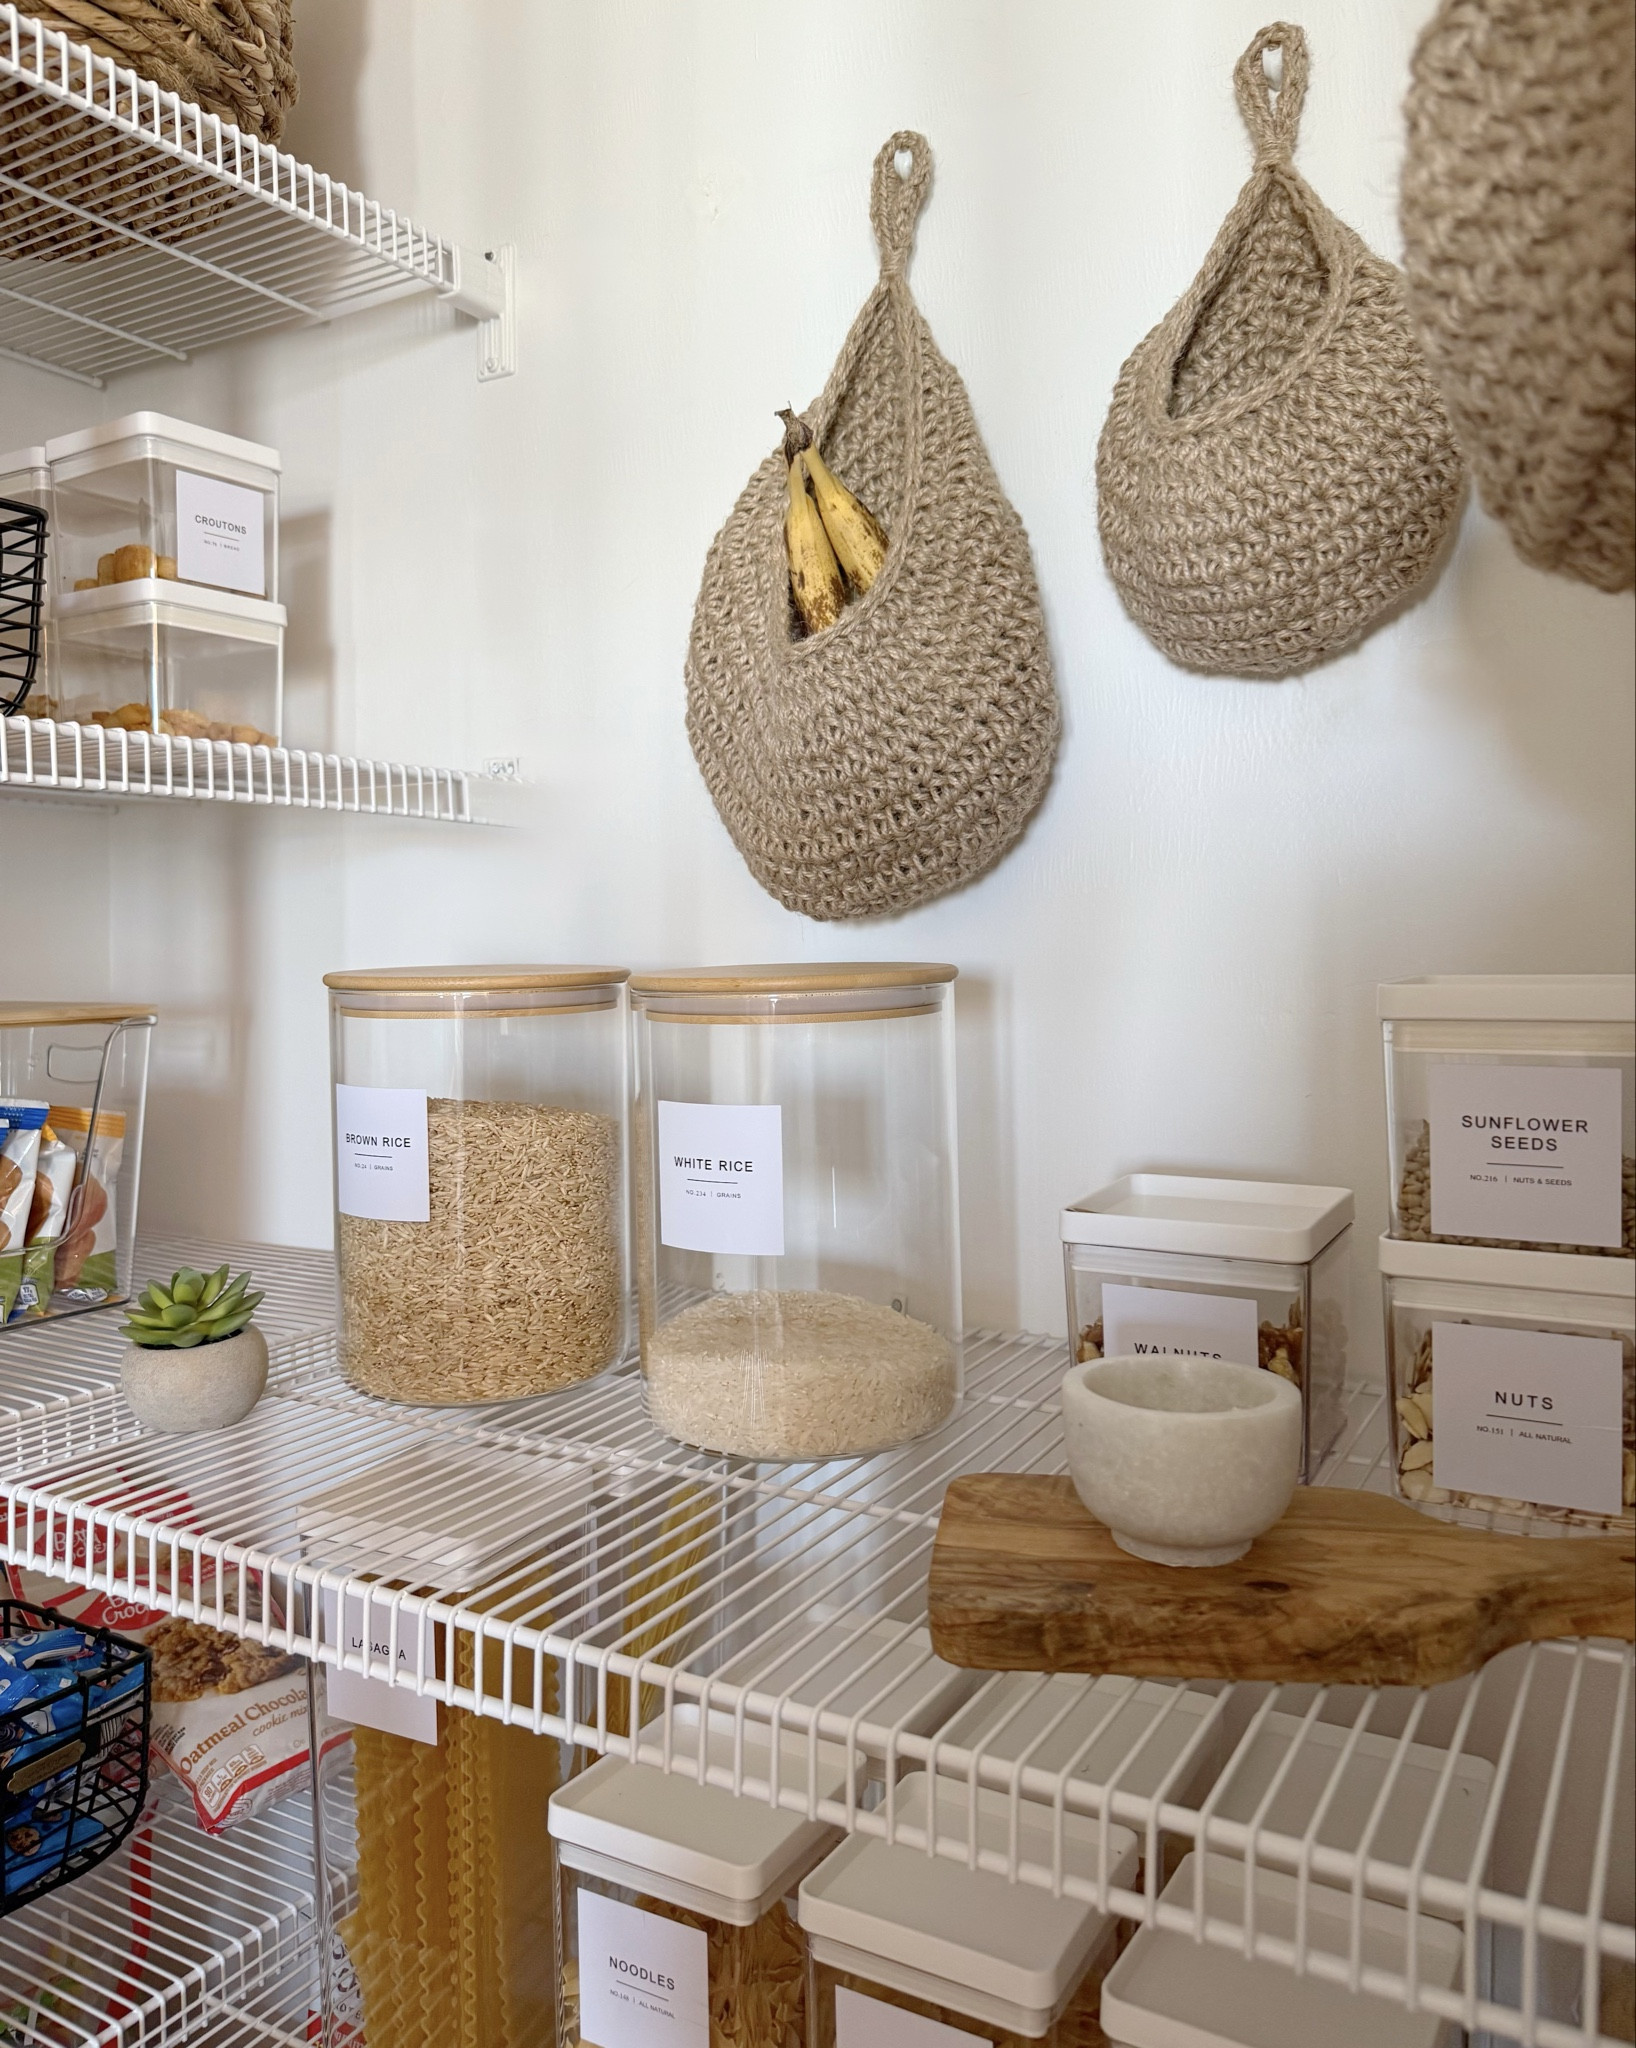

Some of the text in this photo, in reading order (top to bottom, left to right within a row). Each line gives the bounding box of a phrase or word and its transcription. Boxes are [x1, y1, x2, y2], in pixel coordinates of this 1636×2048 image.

[195, 515, 247, 535] CROUTONS
[1461, 1115, 1589, 1133] SUNFLOWER
[346, 1133, 412, 1148] BROWN RICE
[1491, 1135, 1558, 1151] SEEDS
[374, 1164, 394, 1172] GRAINS
[674, 1156, 754, 1173] WHITE RICE
[1513, 1177, 1535, 1185] NUTS
[1545, 1178, 1573, 1186] SEEDS
[1495, 1391, 1554, 1411] NUTS
[1519, 1431, 1534, 1439] ALL
[1535, 1433, 1573, 1444] NATURAL
[351, 1637, 407, 1661] LAAGA
[253, 1713, 289, 1738] cookie
[180, 1713, 248, 1775] Oatmeal
[609, 1955, 675, 1991] NOODLES
[638, 2001, 649, 2009] ALL
[650, 2005, 676, 2020] NATURAL
